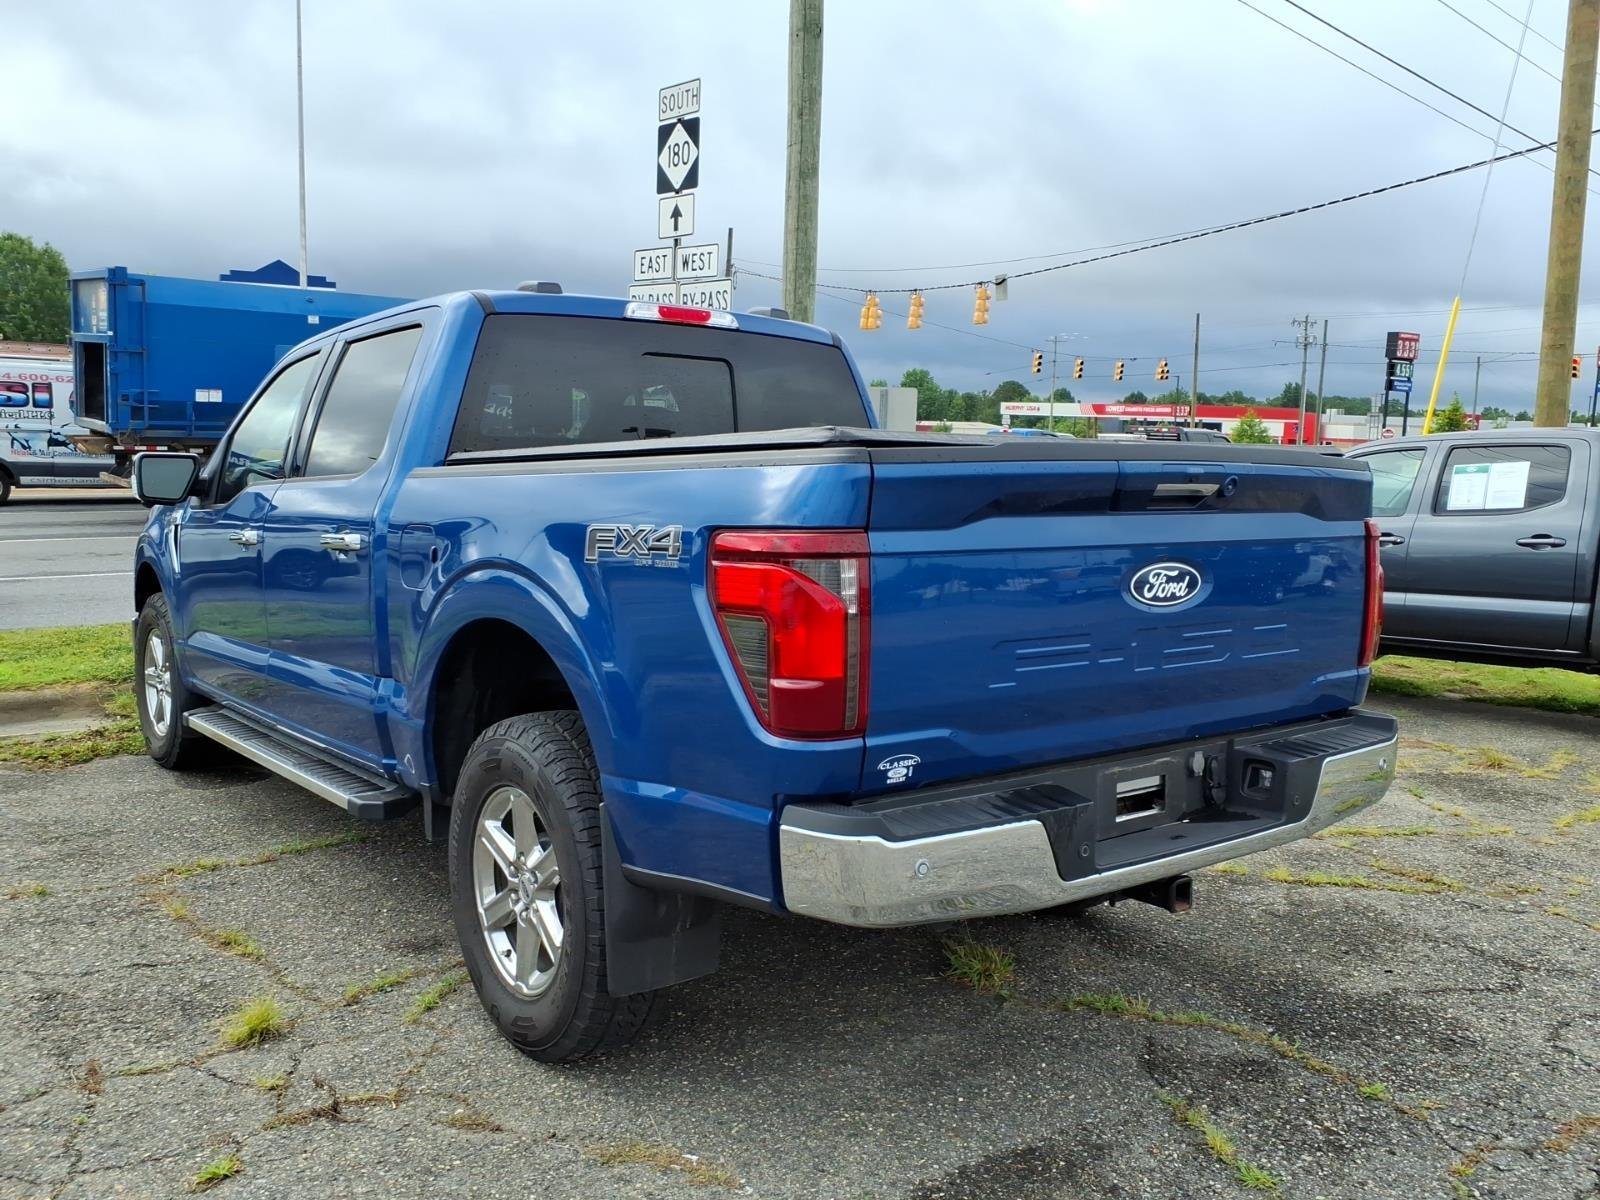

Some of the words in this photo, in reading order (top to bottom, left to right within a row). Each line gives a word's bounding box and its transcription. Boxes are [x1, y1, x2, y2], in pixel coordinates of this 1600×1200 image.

[661, 87, 699, 114] SOUTH
[667, 140, 691, 168] 180
[640, 254, 668, 275] EAST
[681, 251, 713, 273] WEST
[584, 523, 683, 564] FX4
[1144, 569, 1190, 599] Ford
[880, 758, 918, 770] CLASSIC
